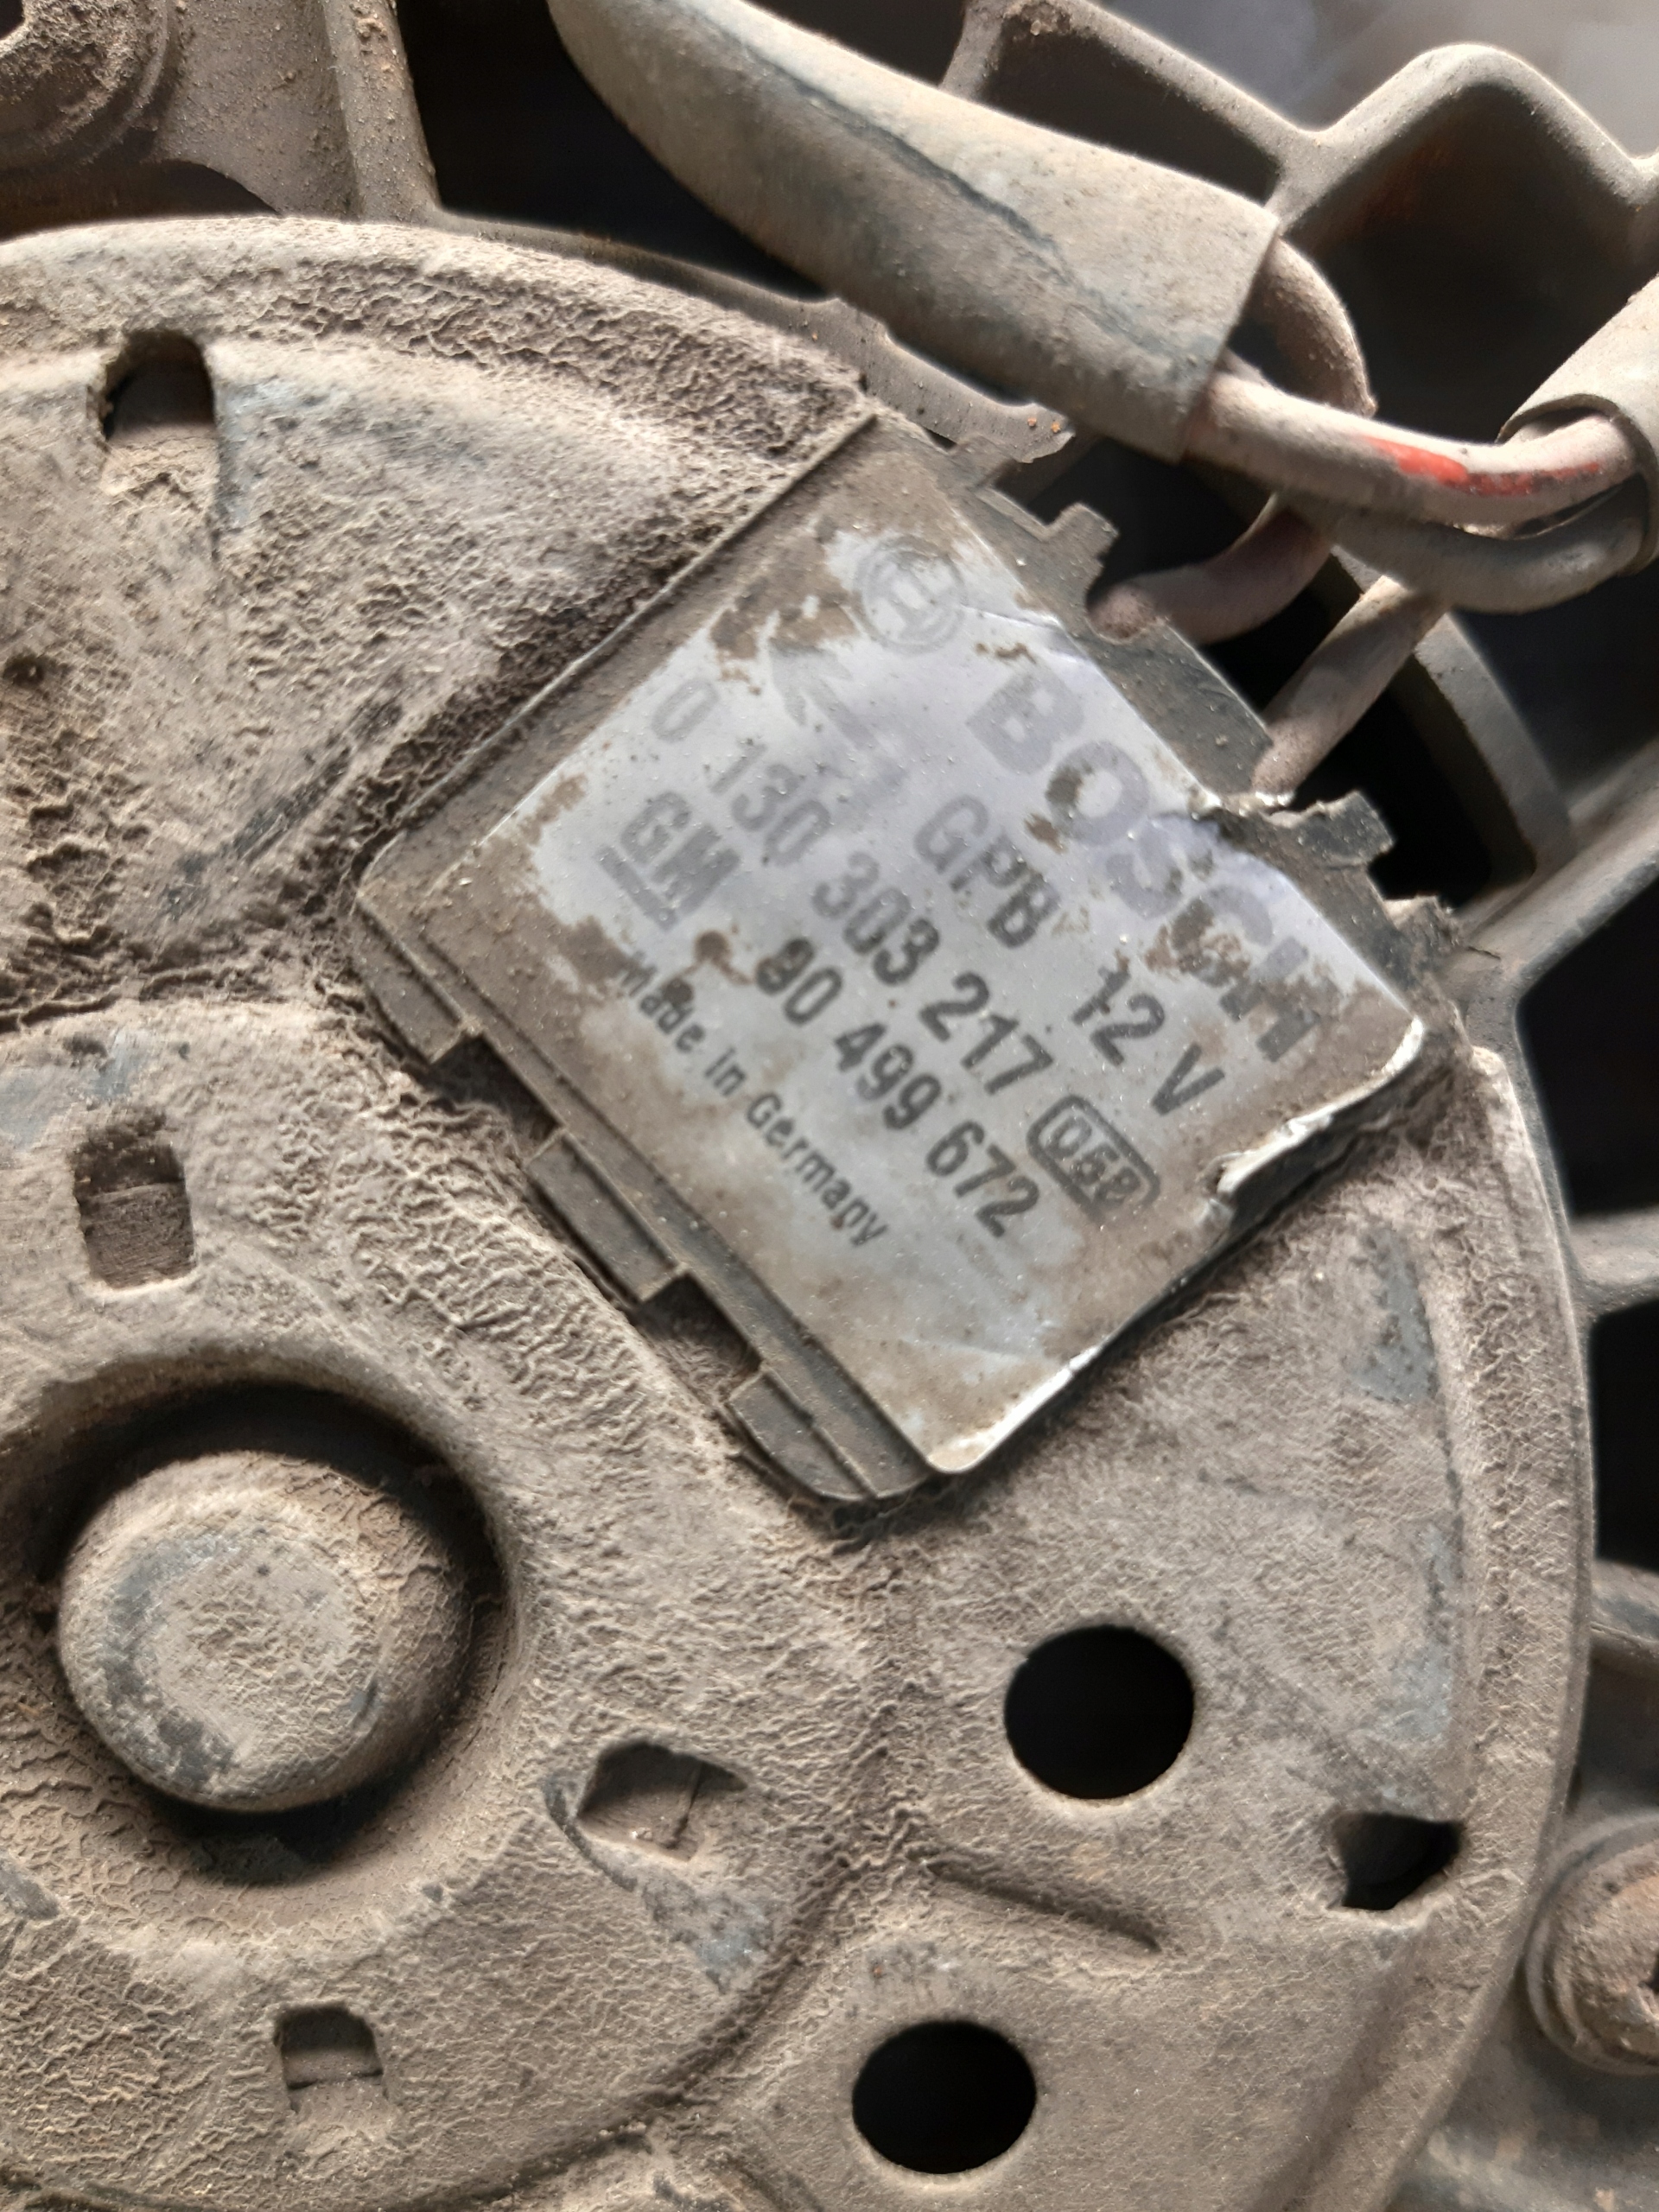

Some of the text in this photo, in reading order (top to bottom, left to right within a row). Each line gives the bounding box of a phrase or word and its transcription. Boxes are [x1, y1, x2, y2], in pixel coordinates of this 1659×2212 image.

[620, 790, 741, 906] GM
[834, 1021, 942, 1130] 499
[925, 1120, 1040, 1239] 672
[650, 677, 721, 743] 0
[709, 742, 832, 865] 130
[810, 850, 940, 985] 303
[918, 970, 1055, 1096] 217
[912, 794, 1226, 1116] GPB 12 V
[965, 669, 1341, 1062] BOSCH
[617, 951, 889, 1247] Made in Germany
